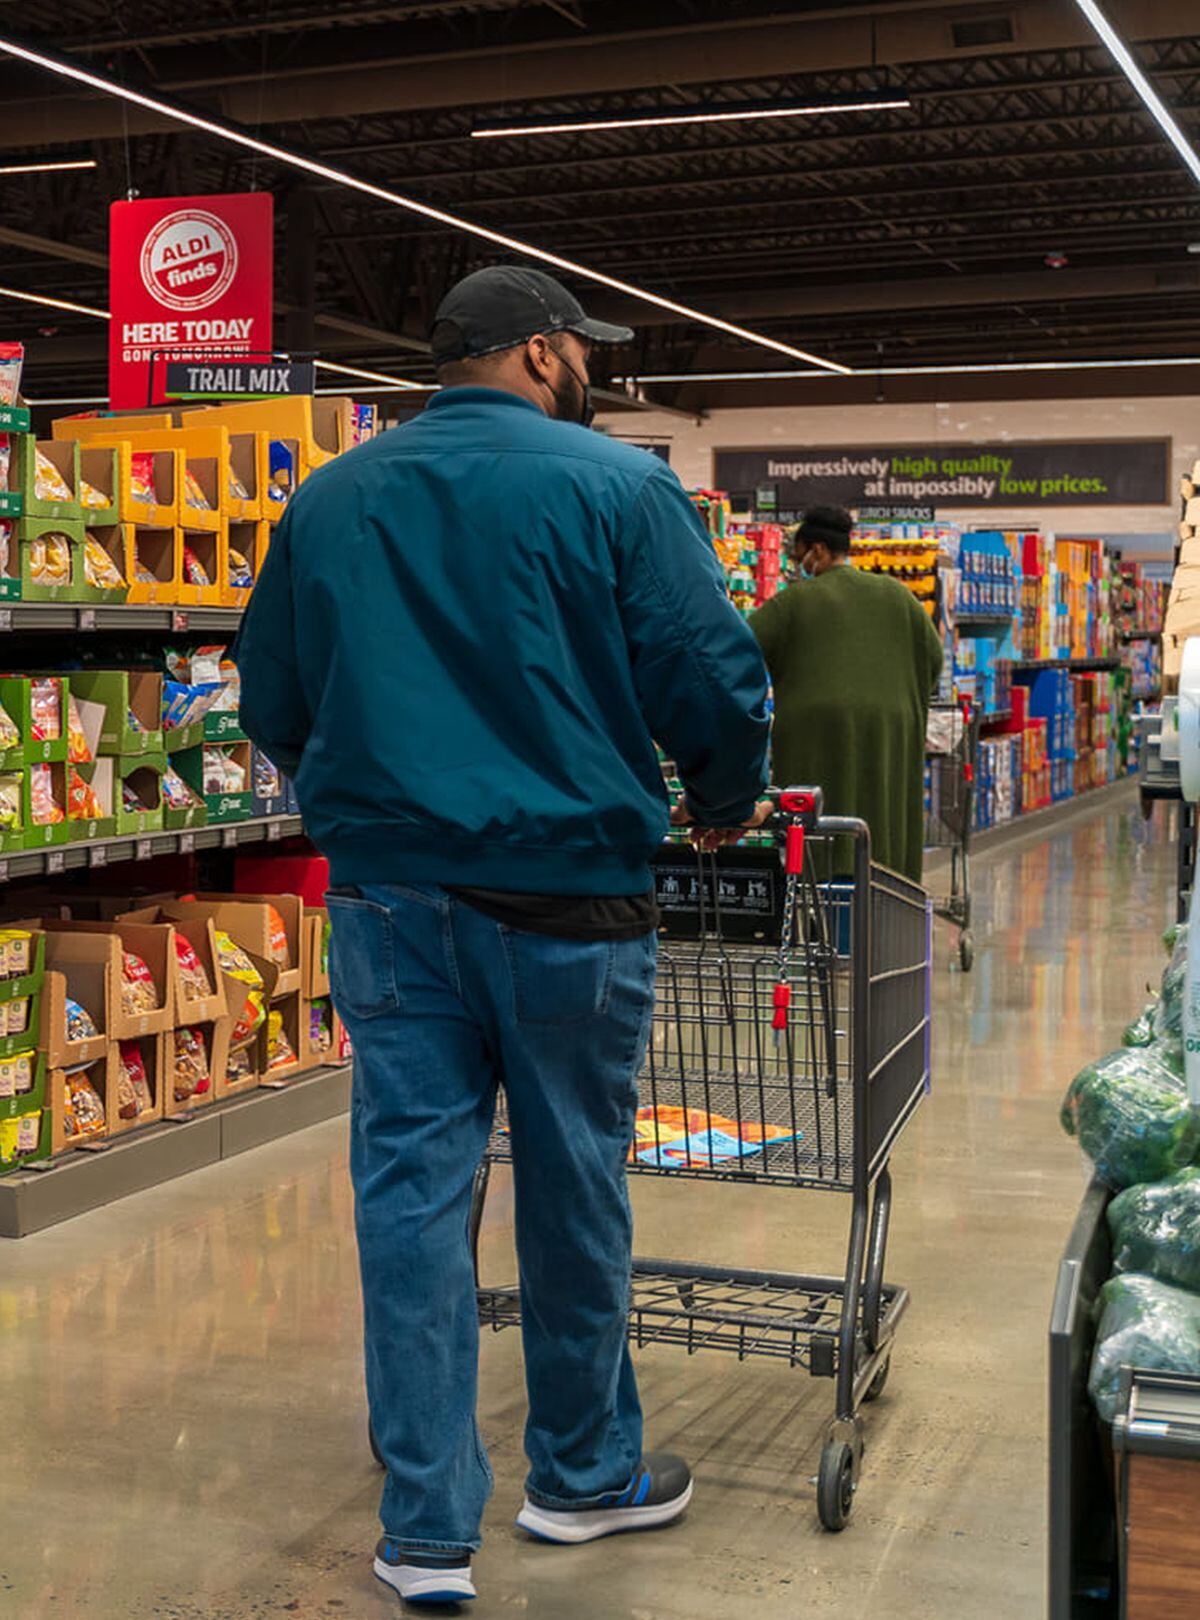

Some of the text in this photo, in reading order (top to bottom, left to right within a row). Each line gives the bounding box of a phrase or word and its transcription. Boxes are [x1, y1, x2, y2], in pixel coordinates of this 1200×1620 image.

[162, 234, 211, 263] ALDI
[166, 262, 218, 288] finds
[123, 318, 254, 343] HERE TODAY
[187, 367, 292, 392] TRAIL MIX
[767, 454, 1013, 481] Impressively high quality
[864, 473, 1107, 499] at impossibly low prices.
